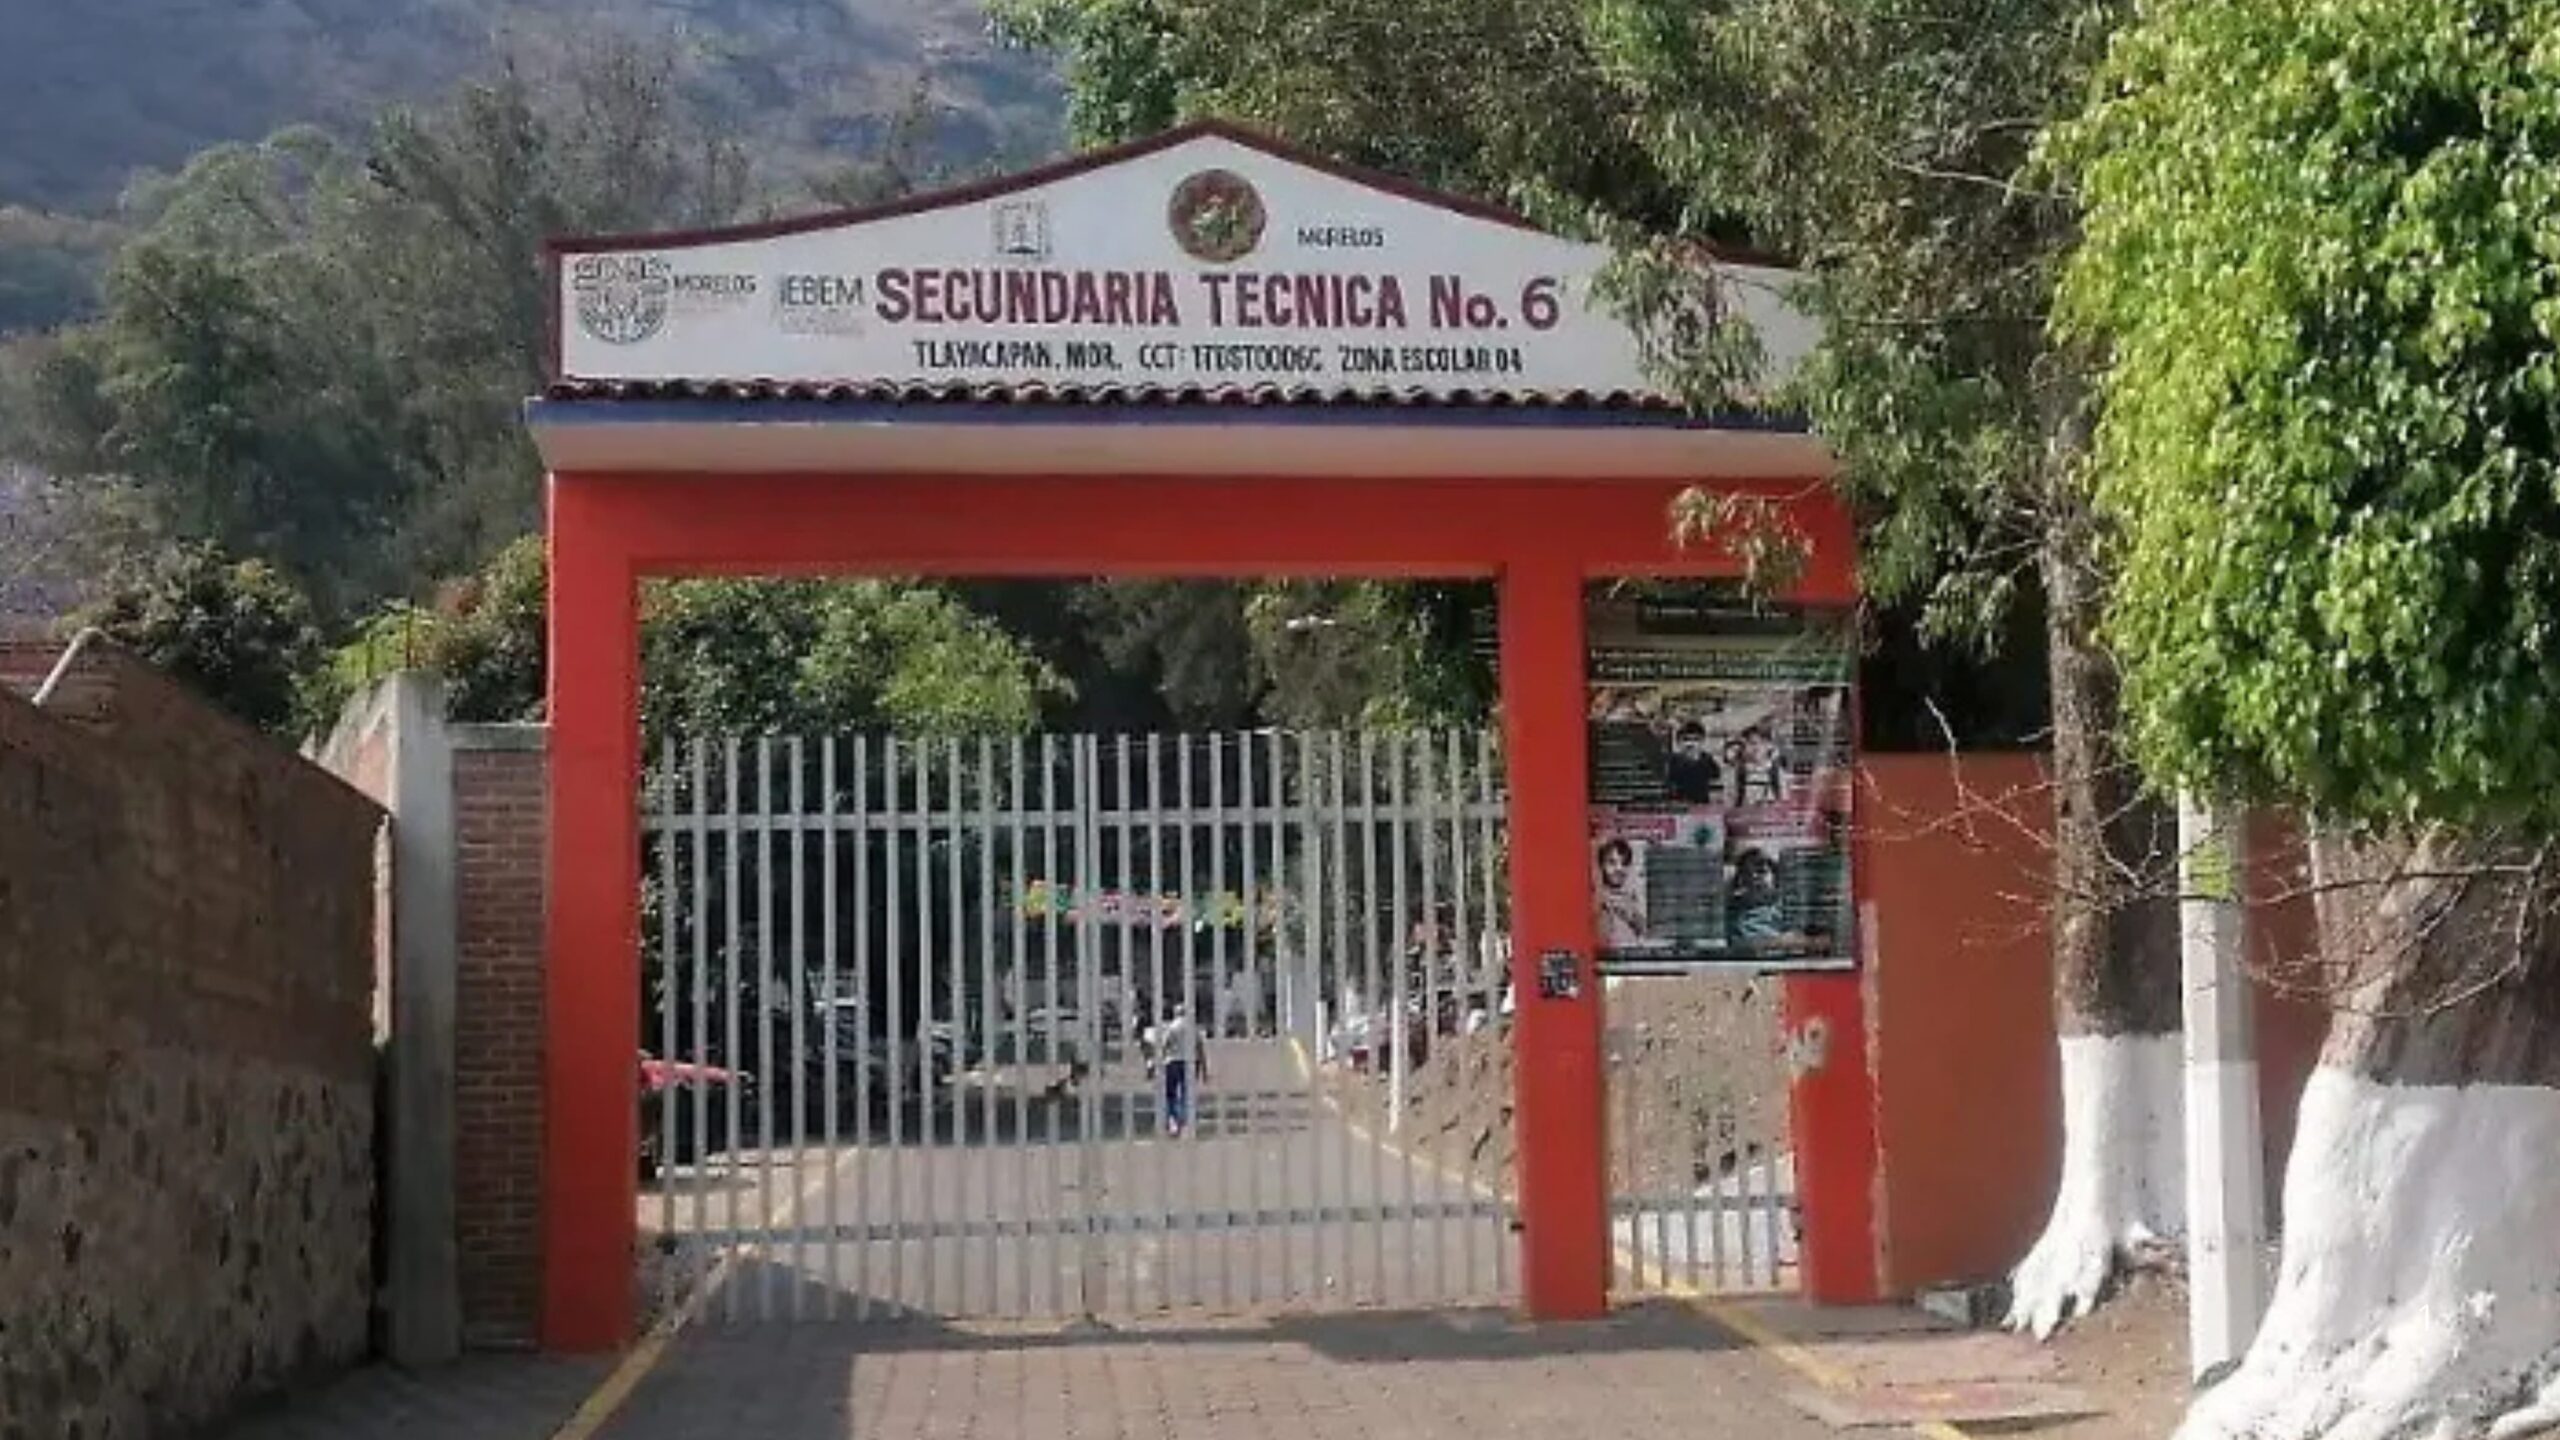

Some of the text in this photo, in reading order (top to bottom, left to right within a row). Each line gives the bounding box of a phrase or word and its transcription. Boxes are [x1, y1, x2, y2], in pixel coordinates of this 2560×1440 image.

[875, 267, 1181, 326] SECUNDARIA
[1199, 273, 1406, 329] TECNICA
[1428, 274, 1508, 330] No.
[1521, 276, 1560, 331] 6
[1339, 344, 1398, 372] ZONA
[1401, 346, 1493, 372] ESCOLAR
